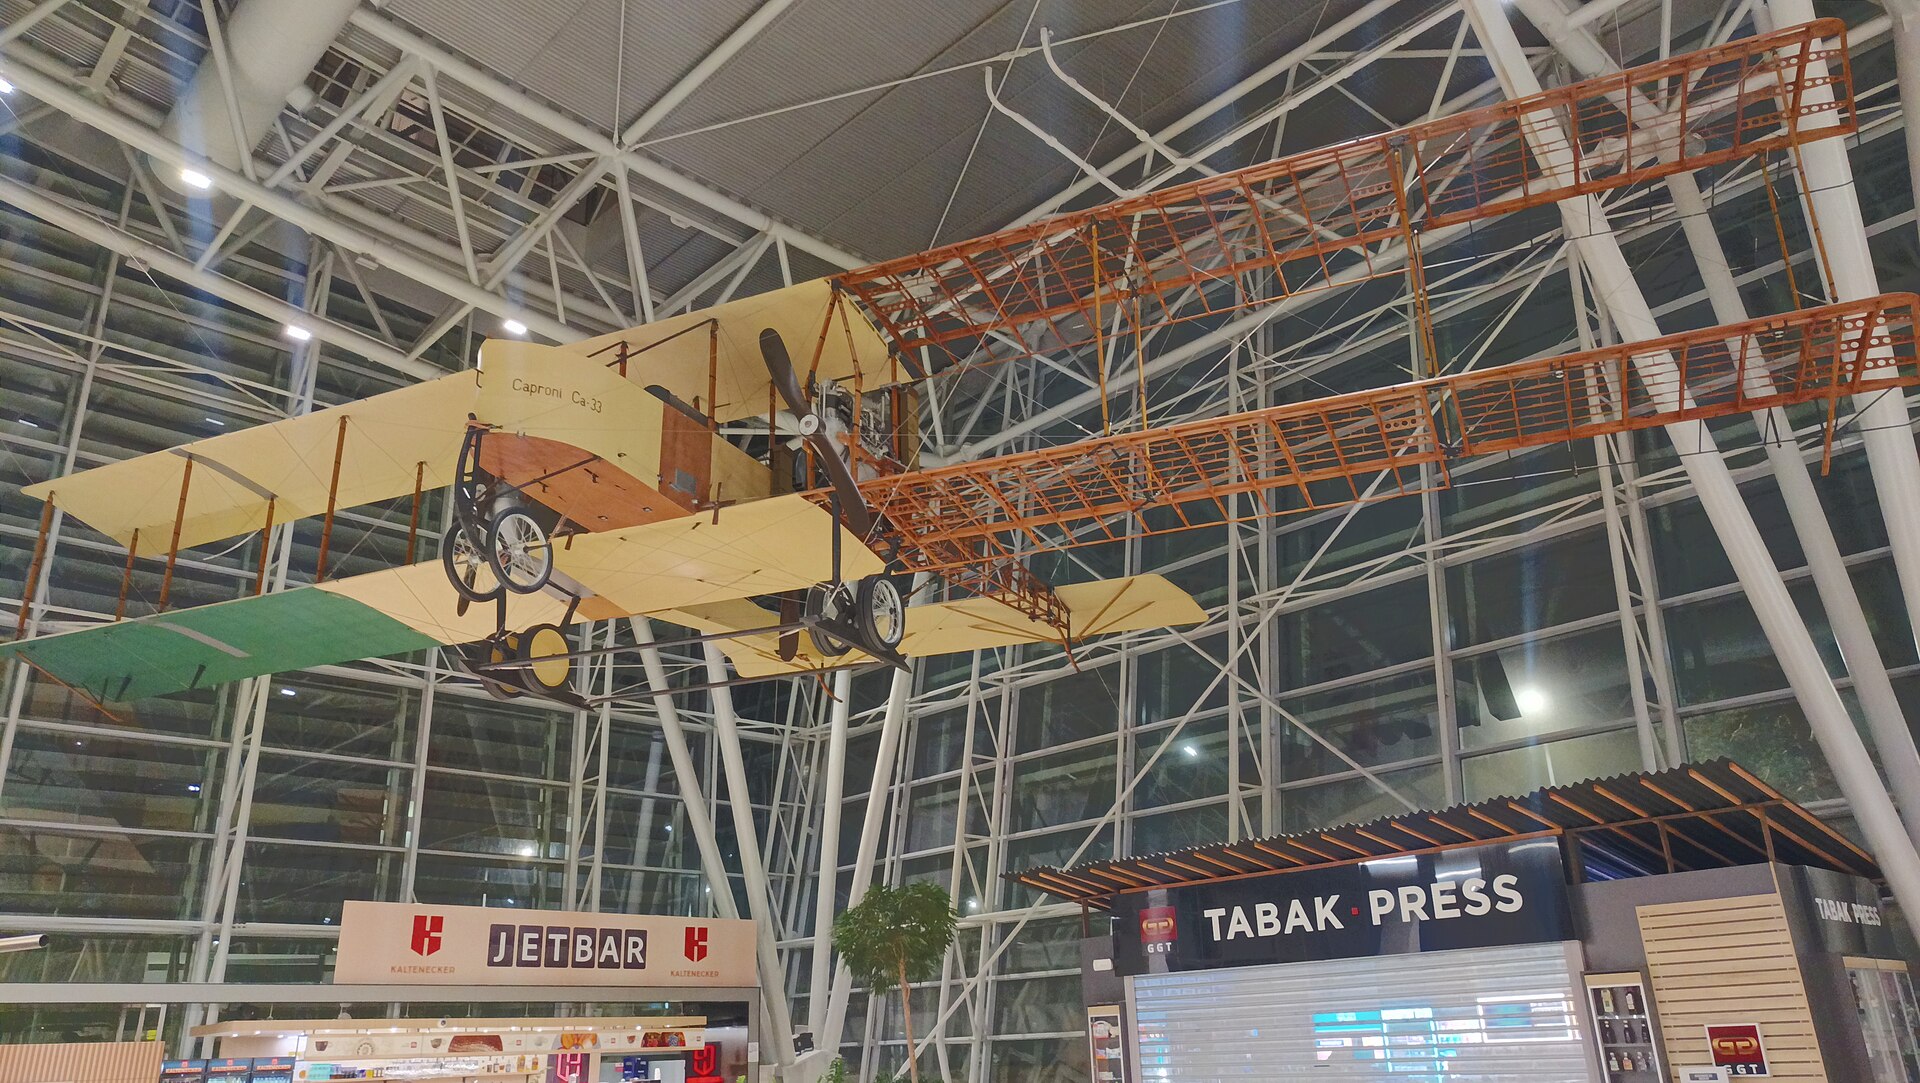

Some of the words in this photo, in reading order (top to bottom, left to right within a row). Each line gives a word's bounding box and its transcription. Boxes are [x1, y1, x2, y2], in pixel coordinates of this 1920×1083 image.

[512, 378, 562, 399] Caproni
[571, 390, 603, 413] Ca-33
[1203, 894, 1345, 941] TABAK
[1368, 874, 1524, 926] PRESS
[1814, 897, 1852, 923] TABAK
[1851, 902, 1881, 926] PRESS
[493, 931, 645, 964] JETBAR
[1147, 942, 1172, 953] GGT
[390, 965, 456, 974] KALTENECKER
[670, 970, 720, 978] KALTENECKER
